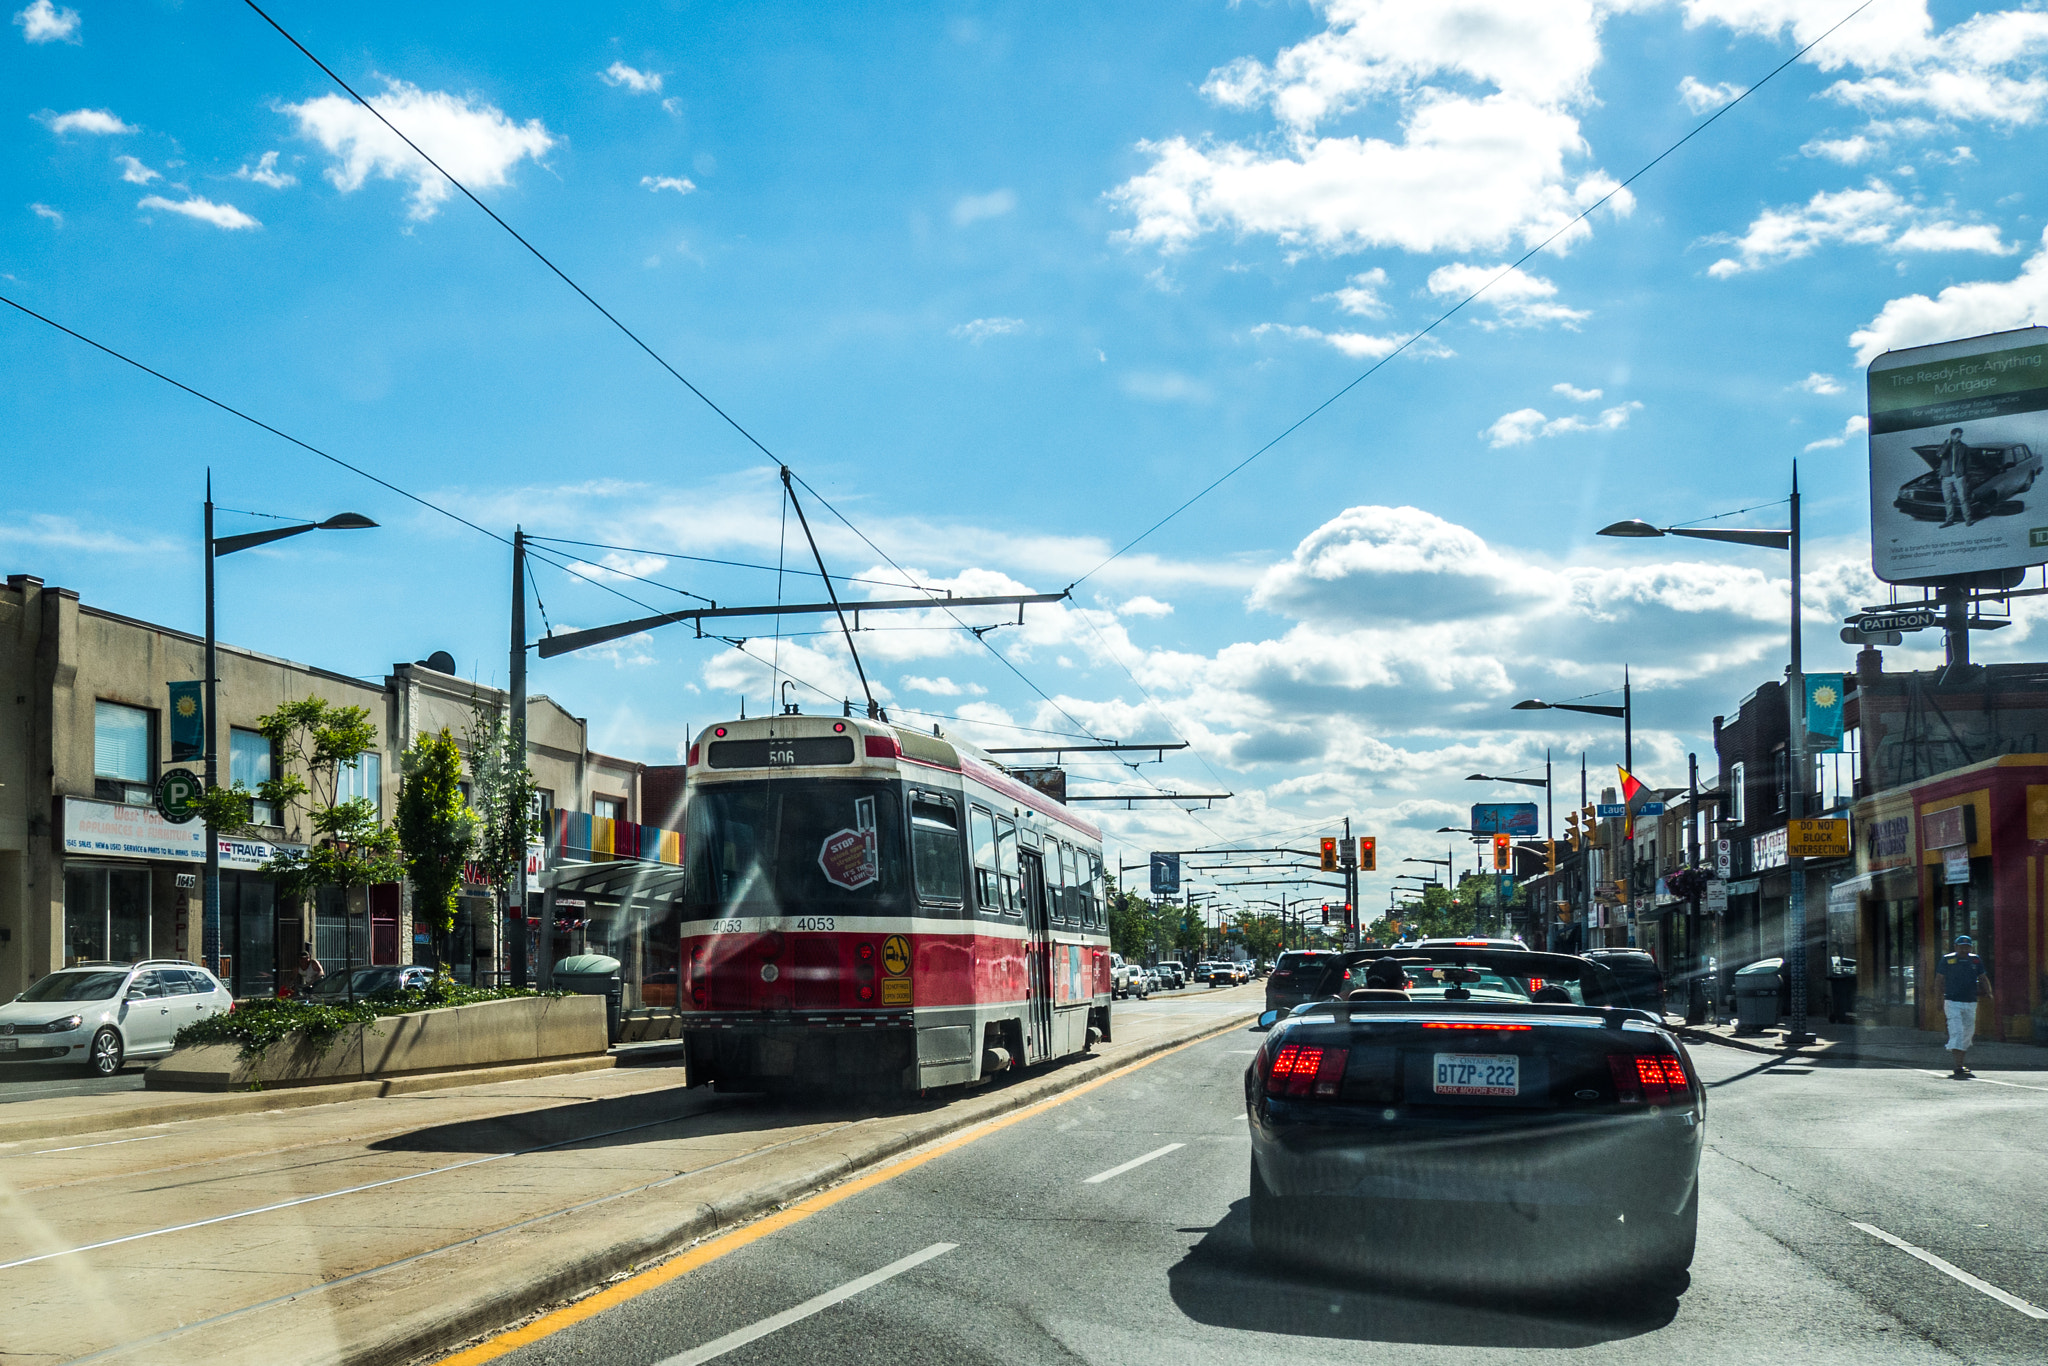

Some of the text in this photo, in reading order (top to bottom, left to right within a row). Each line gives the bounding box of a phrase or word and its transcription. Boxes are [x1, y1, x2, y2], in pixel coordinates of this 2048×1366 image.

[1891, 354, 2042, 387] The Ready-For-Anything
[1934, 377, 1998, 395] Mortgage
[1864, 613, 1929, 630] PATTISON
[769, 750, 794, 764] 506
[171, 783, 189, 804] P
[114, 806, 140, 821] West
[1603, 804, 1647, 816] Laugn
[79, 820, 133, 837] APPLIANCES
[147, 828, 193, 841] FURNITURE
[1801, 821, 1835, 830] DO NOT
[1803, 833, 1833, 842] BLOCK
[230, 844, 268, 857] TRAVEL
[830, 837, 855, 853] STOP
[1791, 845, 1846, 854] INTERSECTION
[177, 875, 195, 887] 1645
[712, 919, 742, 933] 4053
[797, 917, 835, 931] 4053
[1437, 1086, 1515, 1096] PARK MOTOR SALES
